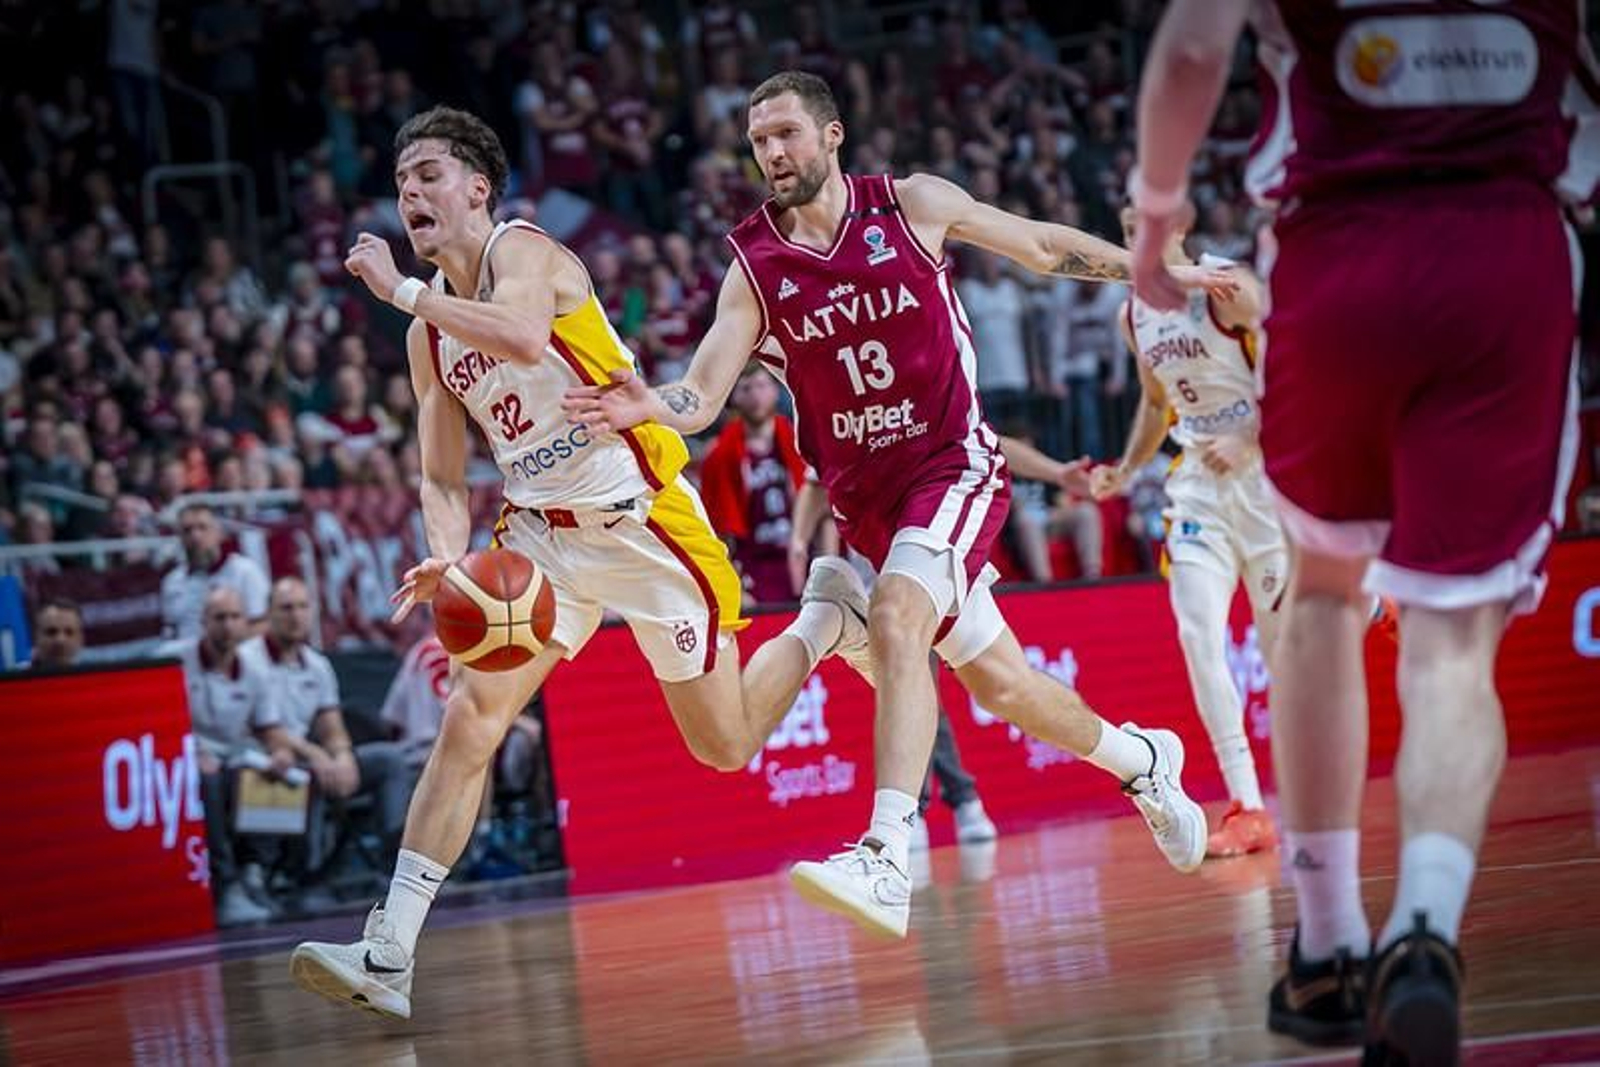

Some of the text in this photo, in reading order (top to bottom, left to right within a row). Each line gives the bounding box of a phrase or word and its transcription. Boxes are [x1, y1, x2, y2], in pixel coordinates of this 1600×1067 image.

[781, 283, 920, 342] LATVIJA
[836, 340, 896, 395] 13
[1177, 378, 1199, 403] 6
[490, 393, 535, 442] 32
[832, 398, 914, 445] OlyBet
